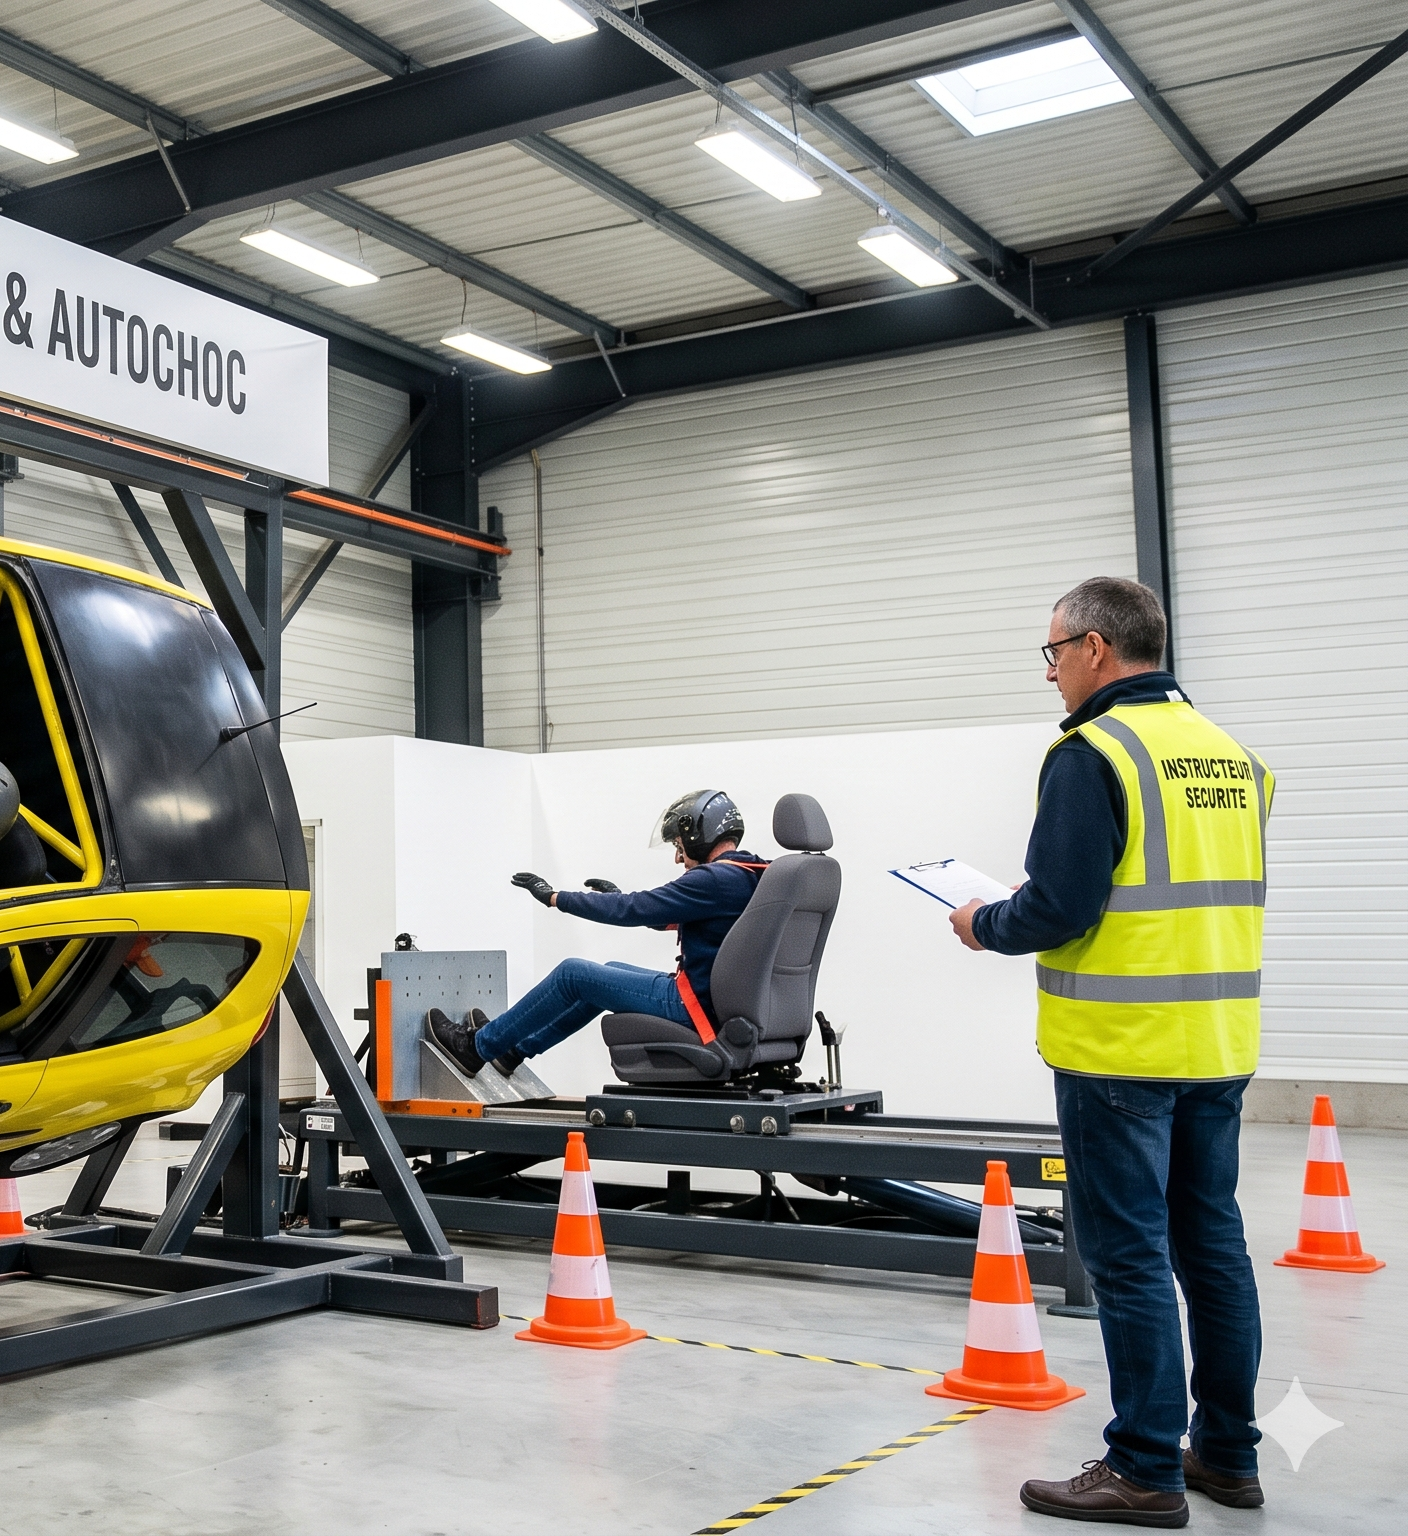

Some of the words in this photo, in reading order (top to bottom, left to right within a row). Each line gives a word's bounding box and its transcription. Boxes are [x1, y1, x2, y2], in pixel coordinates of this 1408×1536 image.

[3, 271, 34, 349] &
[47, 288, 248, 415] AUTOCHOC
[1160, 757, 1253, 781] INSTRUCTEUR
[1185, 786, 1247, 809] SECURITE
